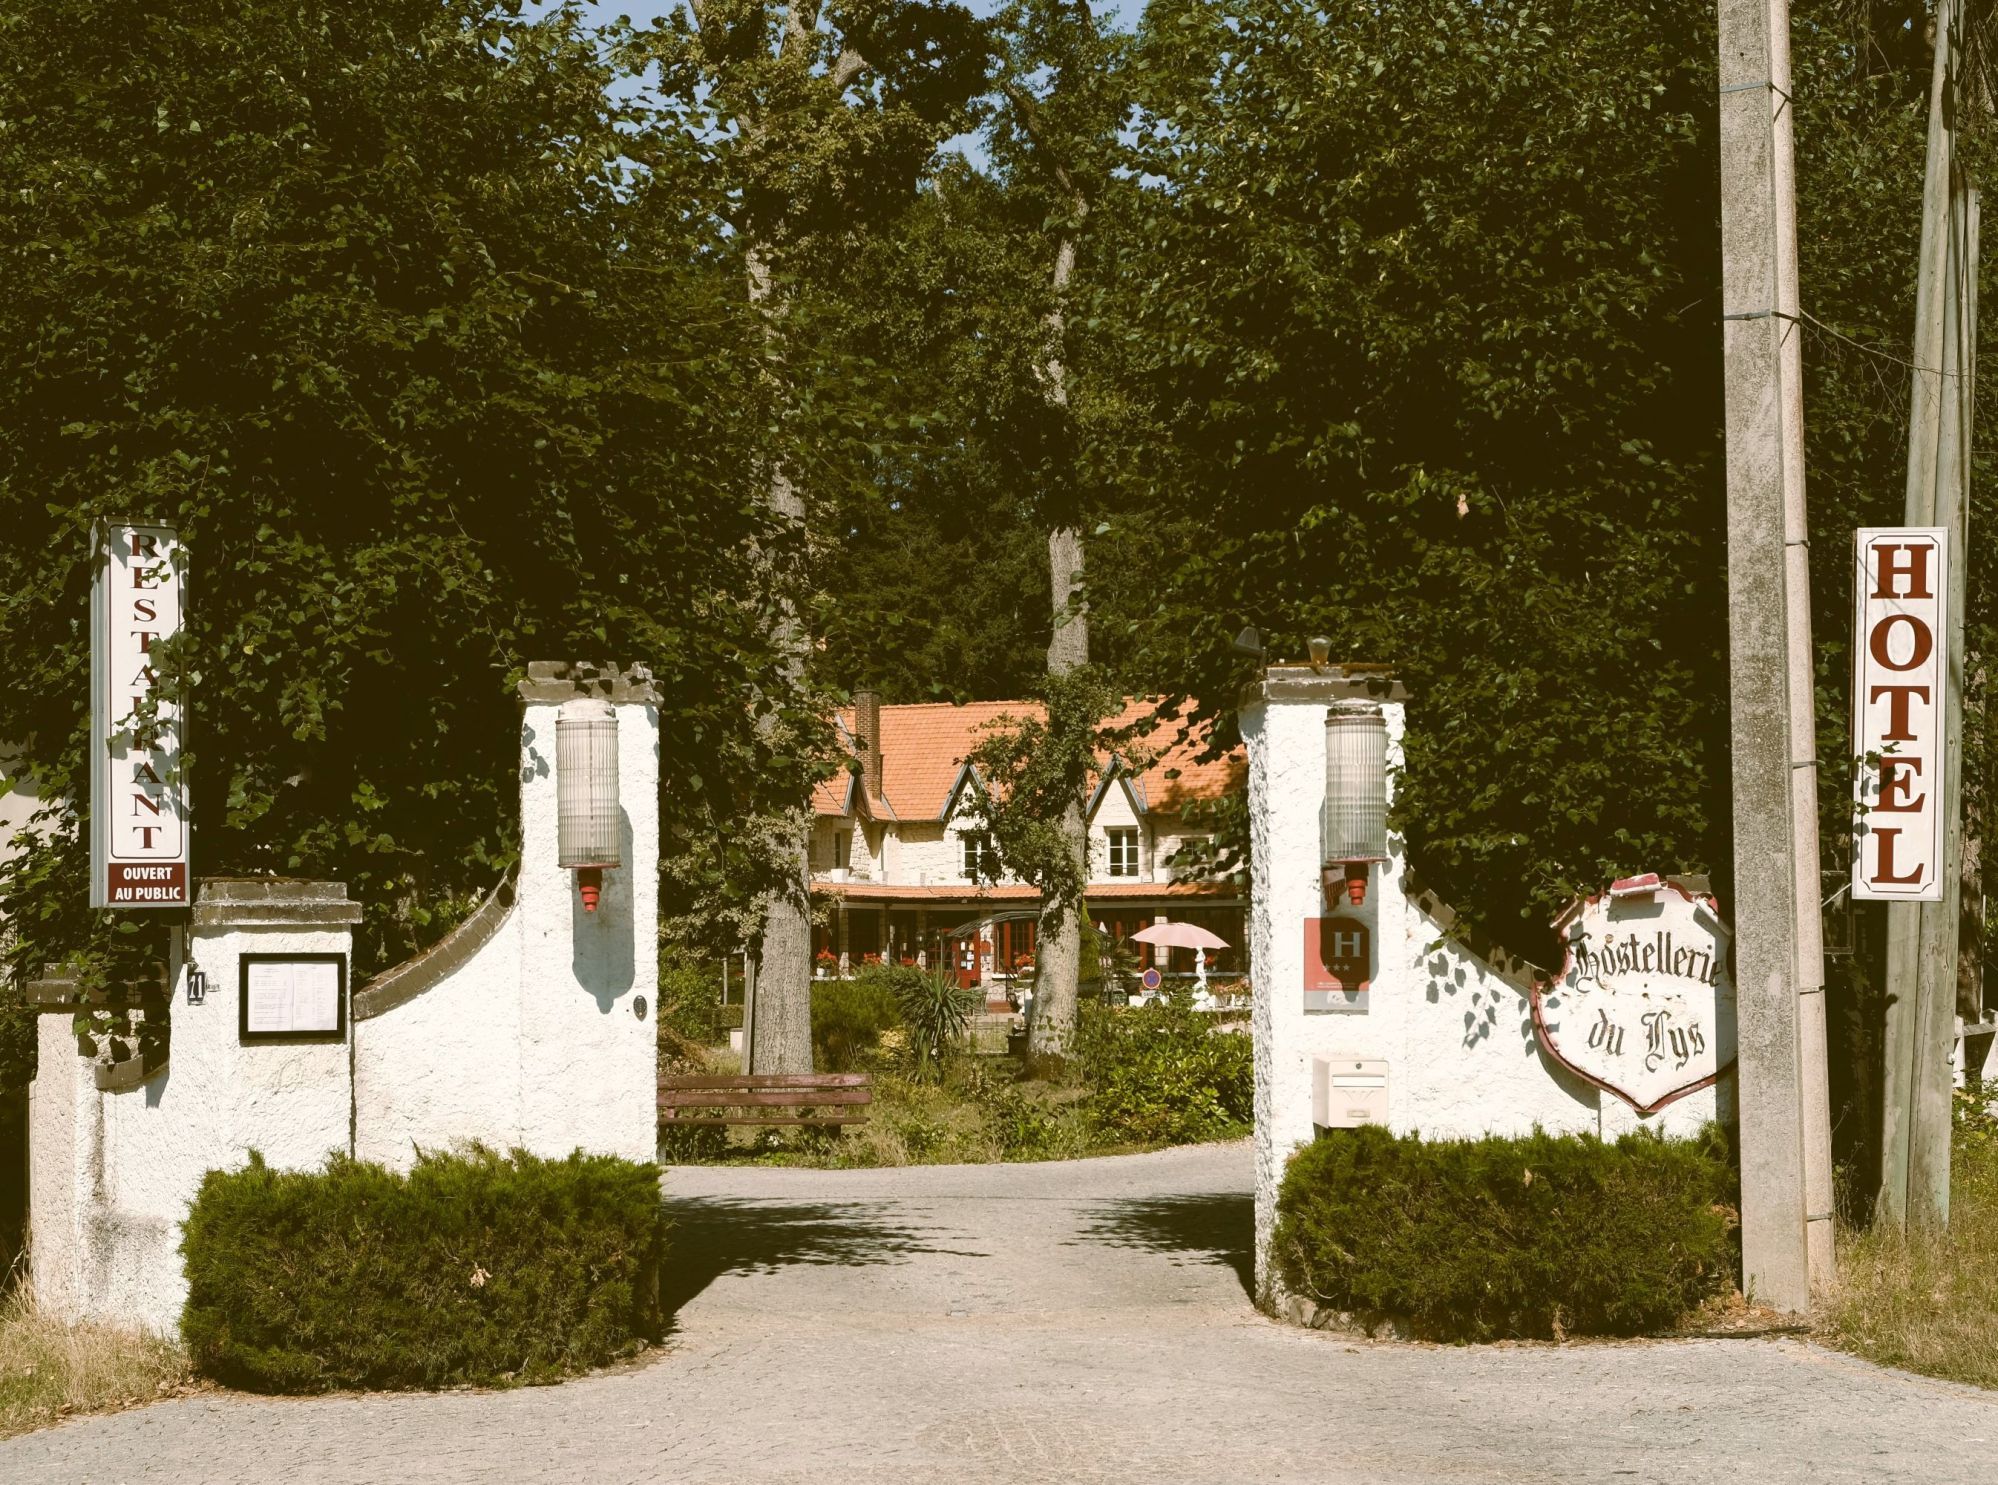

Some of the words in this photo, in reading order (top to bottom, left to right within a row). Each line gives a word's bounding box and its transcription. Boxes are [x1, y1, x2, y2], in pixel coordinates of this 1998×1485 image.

[129, 534, 164, 849] RESTARANT
[1870, 544, 1934, 884] HOTEL
[115, 887, 132, 900] AU
[135, 886, 181, 900] PUBLIC
[123, 867, 172, 880] OUVERT
[1332, 932, 1365, 958] H
[1588, 1008, 1626, 1056] du
[1641, 1010, 1706, 1073] Lys
